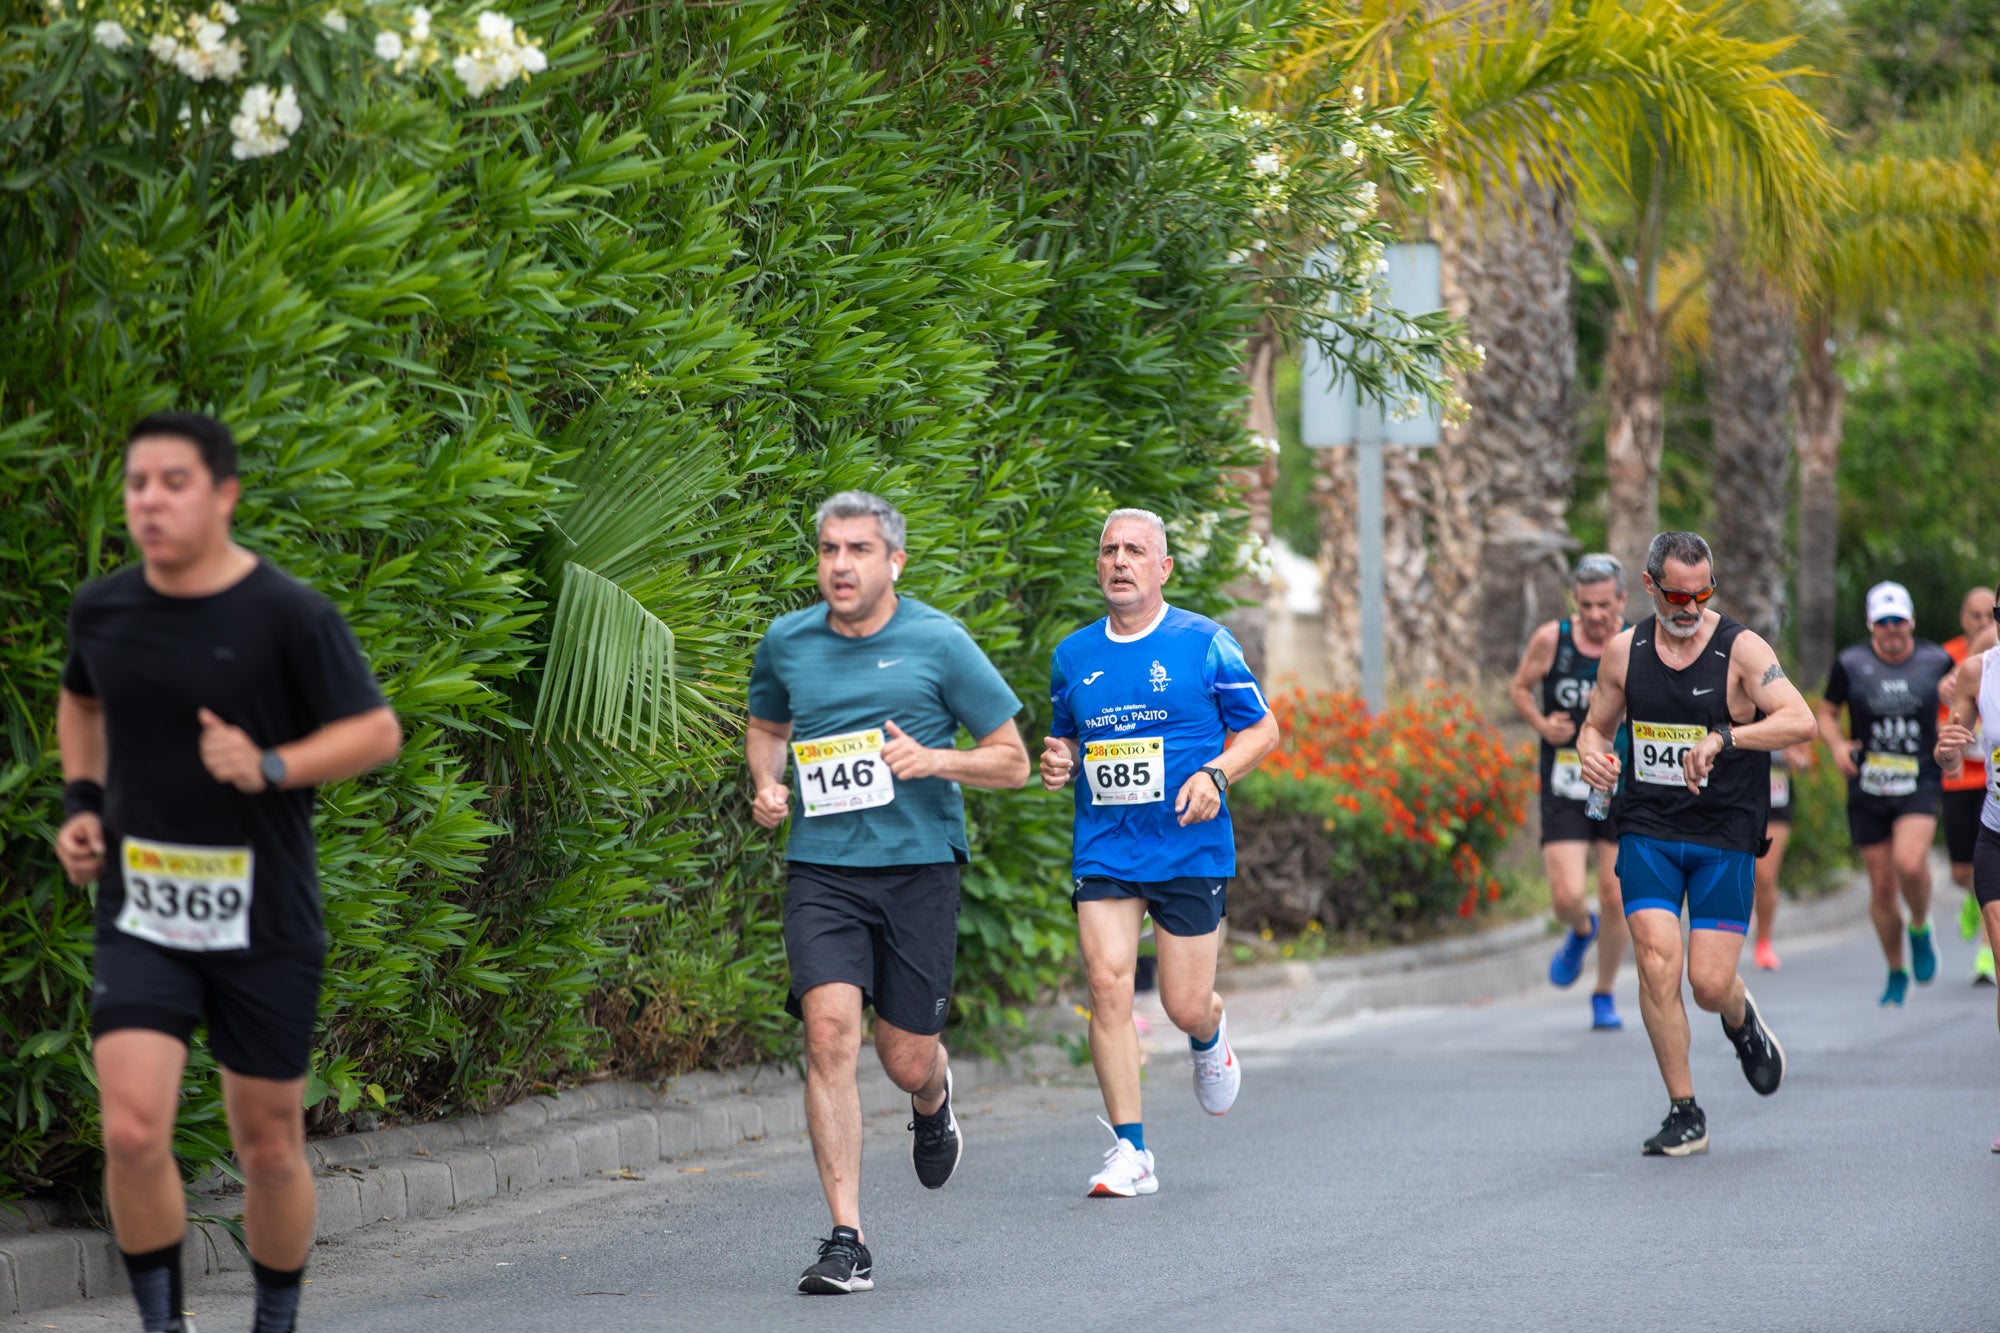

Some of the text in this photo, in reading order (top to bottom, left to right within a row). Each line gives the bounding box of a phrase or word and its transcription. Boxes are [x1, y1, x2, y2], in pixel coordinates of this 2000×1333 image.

[1085, 715, 1117, 728] PAZITO
[1131, 710, 1168, 720] PAZITO
[1642, 726, 1652, 737] 38
[1093, 745, 1145, 757] 38 FONDO
[812, 760, 874, 794] 146
[1096, 761, 1151, 788] 685
[131, 877, 242, 922] 3369
